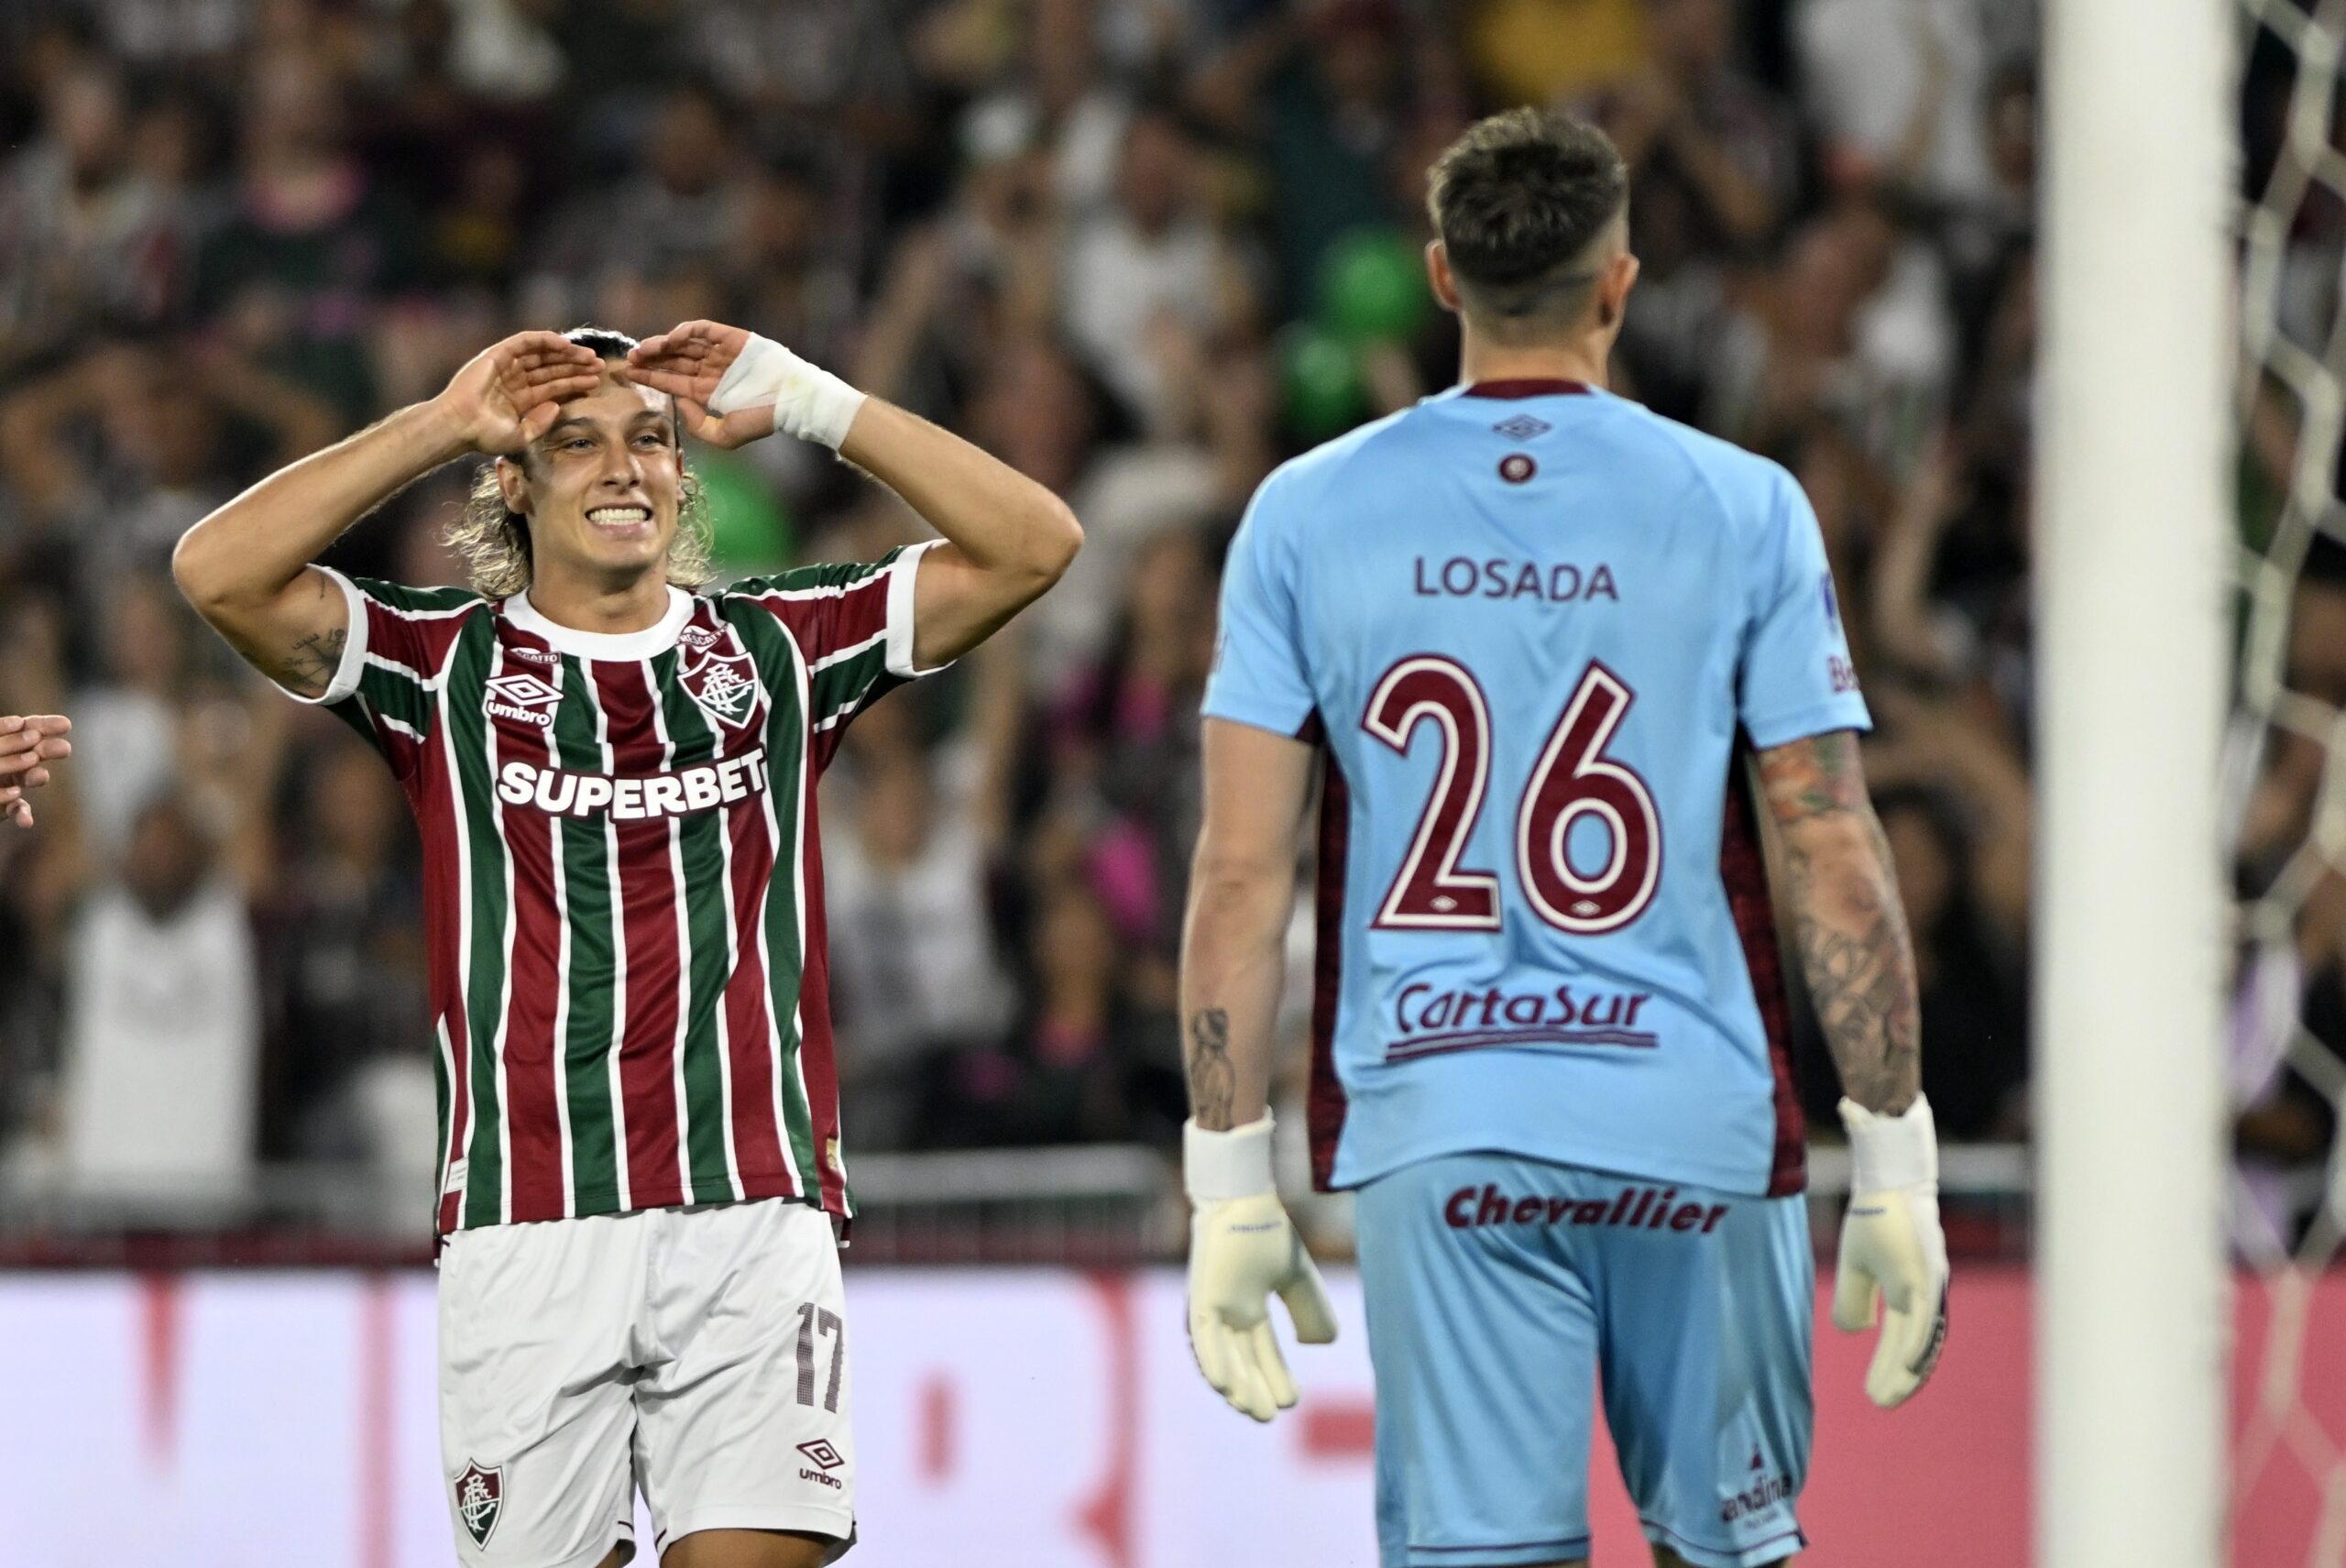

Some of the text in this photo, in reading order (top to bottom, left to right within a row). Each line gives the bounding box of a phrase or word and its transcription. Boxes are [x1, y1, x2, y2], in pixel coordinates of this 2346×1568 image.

[1415, 555, 1619, 602] LOSADA
[487, 700, 552, 727] umbro
[497, 747, 767, 819] SUPERBET
[1360, 652, 1664, 936] 26
[1397, 983, 1652, 1034] CartaSur
[1444, 1184, 1731, 1234] Chevallier
[797, 1302, 843, 1414] 17
[799, 1467, 842, 1491] umbro
